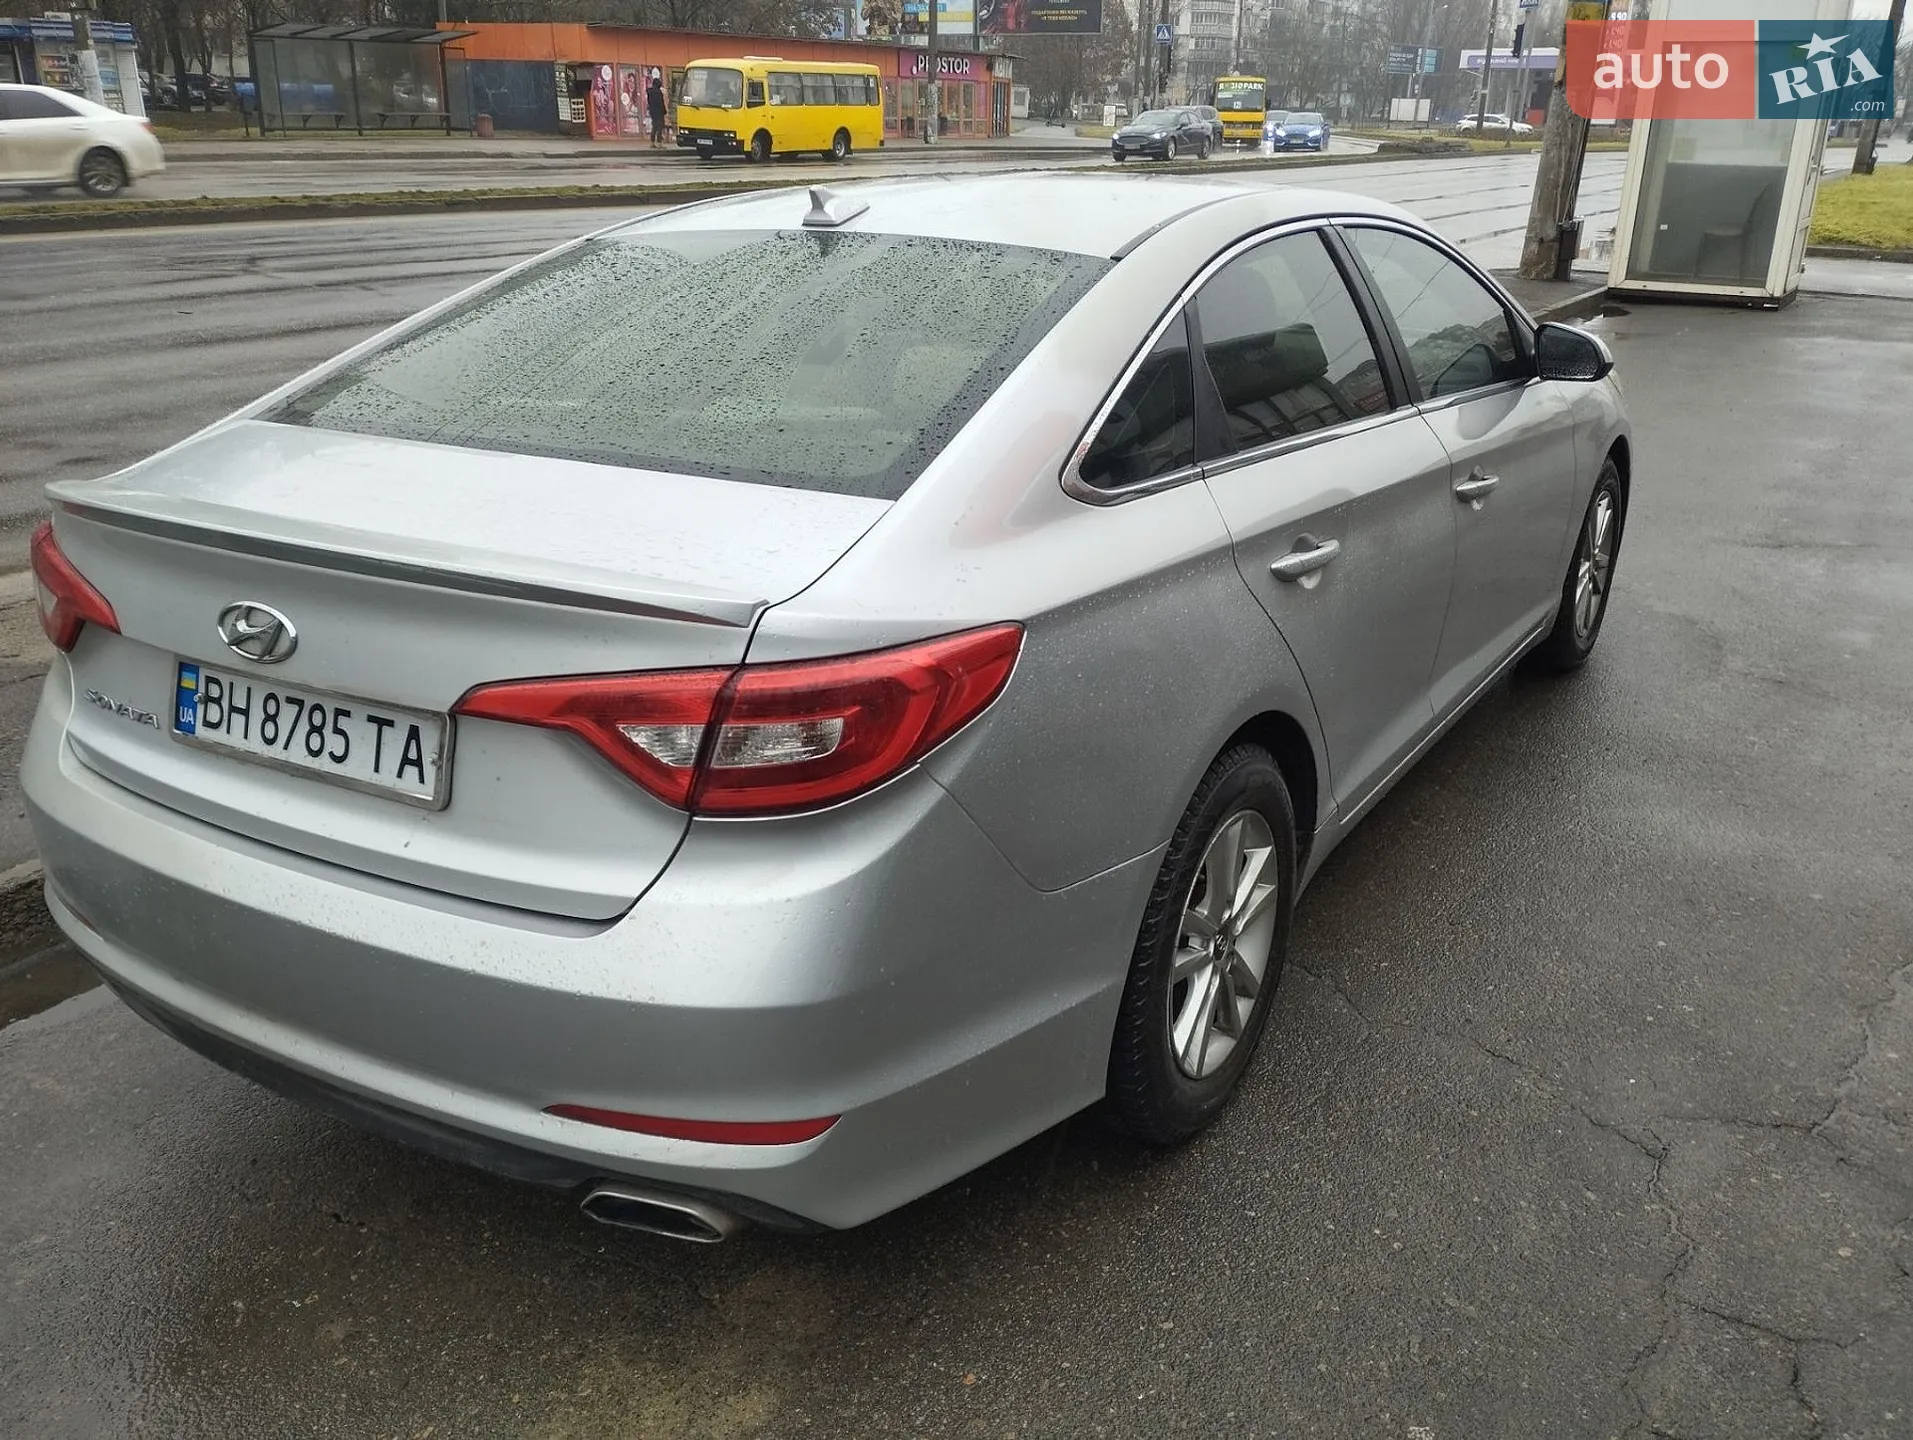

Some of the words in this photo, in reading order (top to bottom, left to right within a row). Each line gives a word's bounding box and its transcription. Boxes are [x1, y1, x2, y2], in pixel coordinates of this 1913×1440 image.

[83, 688, 160, 730] SONATA
[179, 706, 196, 726] UA
[201, 675, 252, 740] BH
[260, 692, 352, 765] 8785
[366, 714, 425, 786] TA
